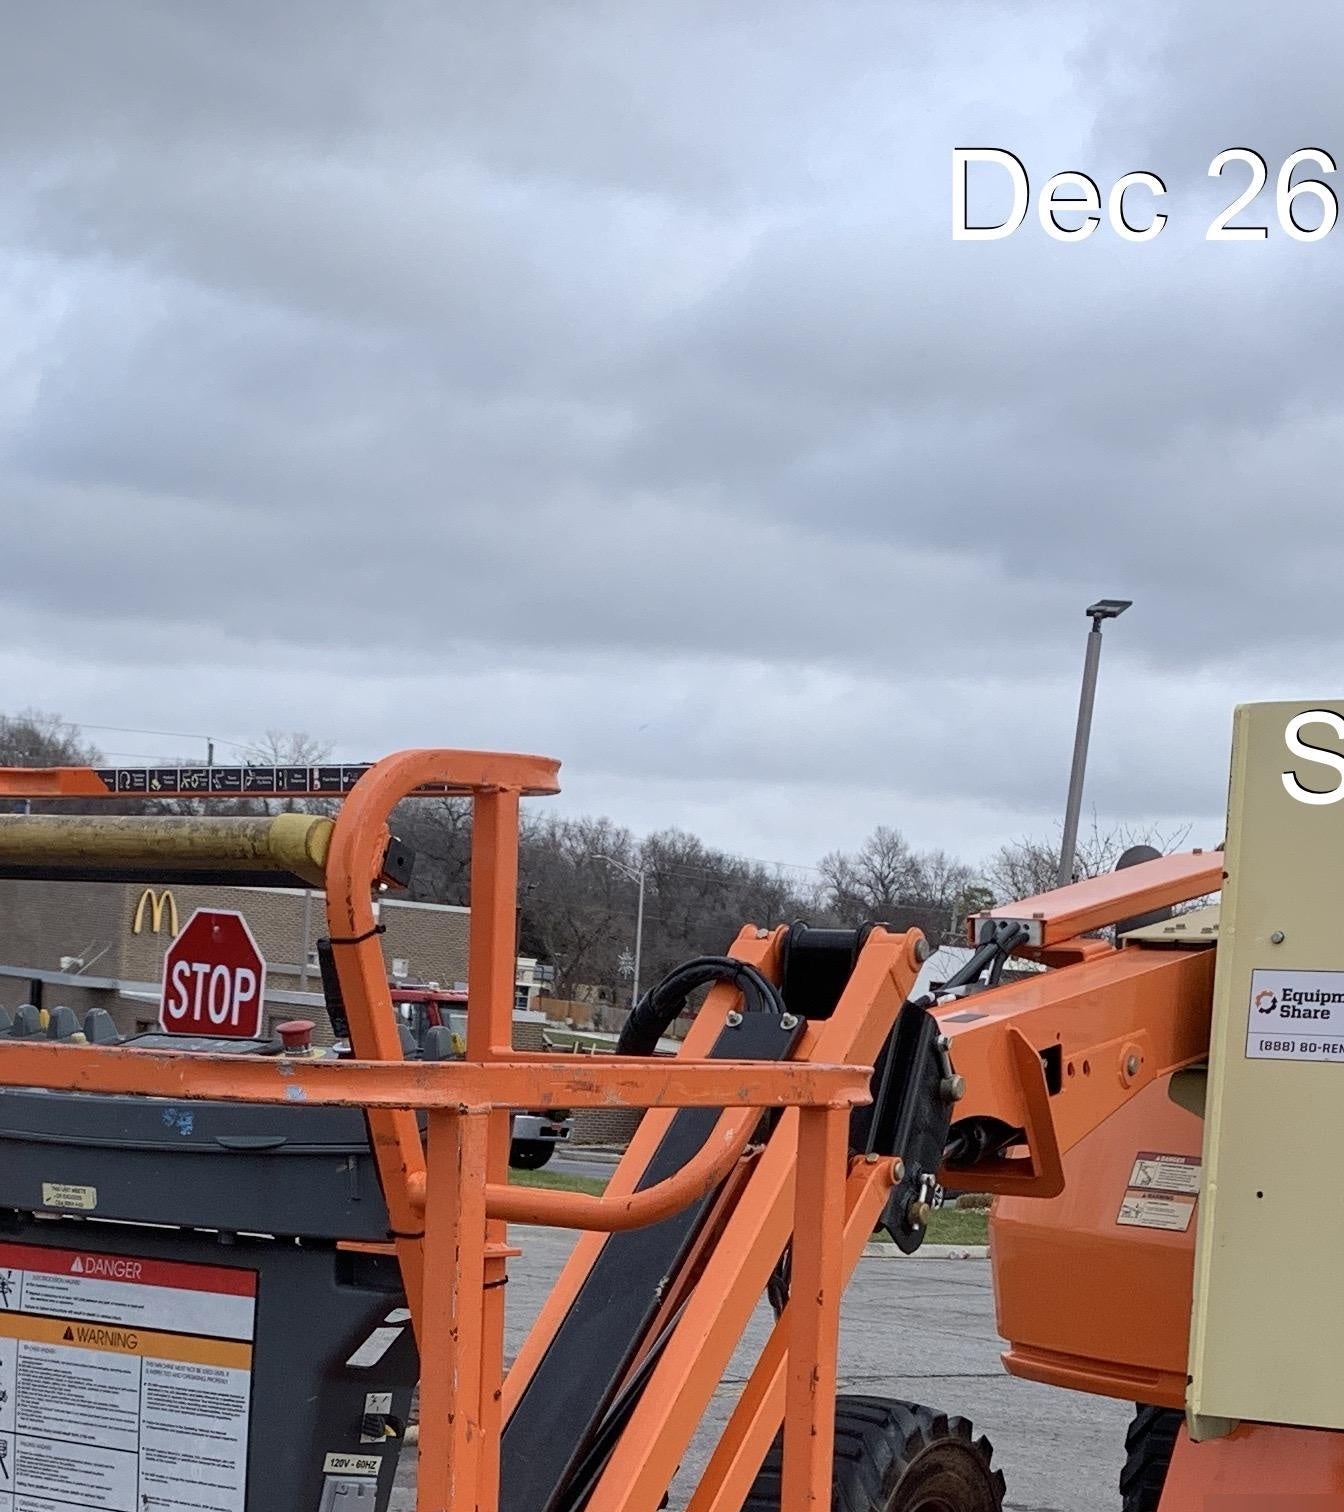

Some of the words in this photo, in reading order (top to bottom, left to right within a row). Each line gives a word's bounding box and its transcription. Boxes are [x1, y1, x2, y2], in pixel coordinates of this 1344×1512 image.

[168, 960, 256, 1026] STOP
[1280, 1005, 1331, 1020] Share
[1259, 1040, 1295, 1053] (888)
[85, 1257, 142, 1280] DANGER
[76, 1327, 139, 1351] WARNING
[330, 1458, 350, 1468] 120V
